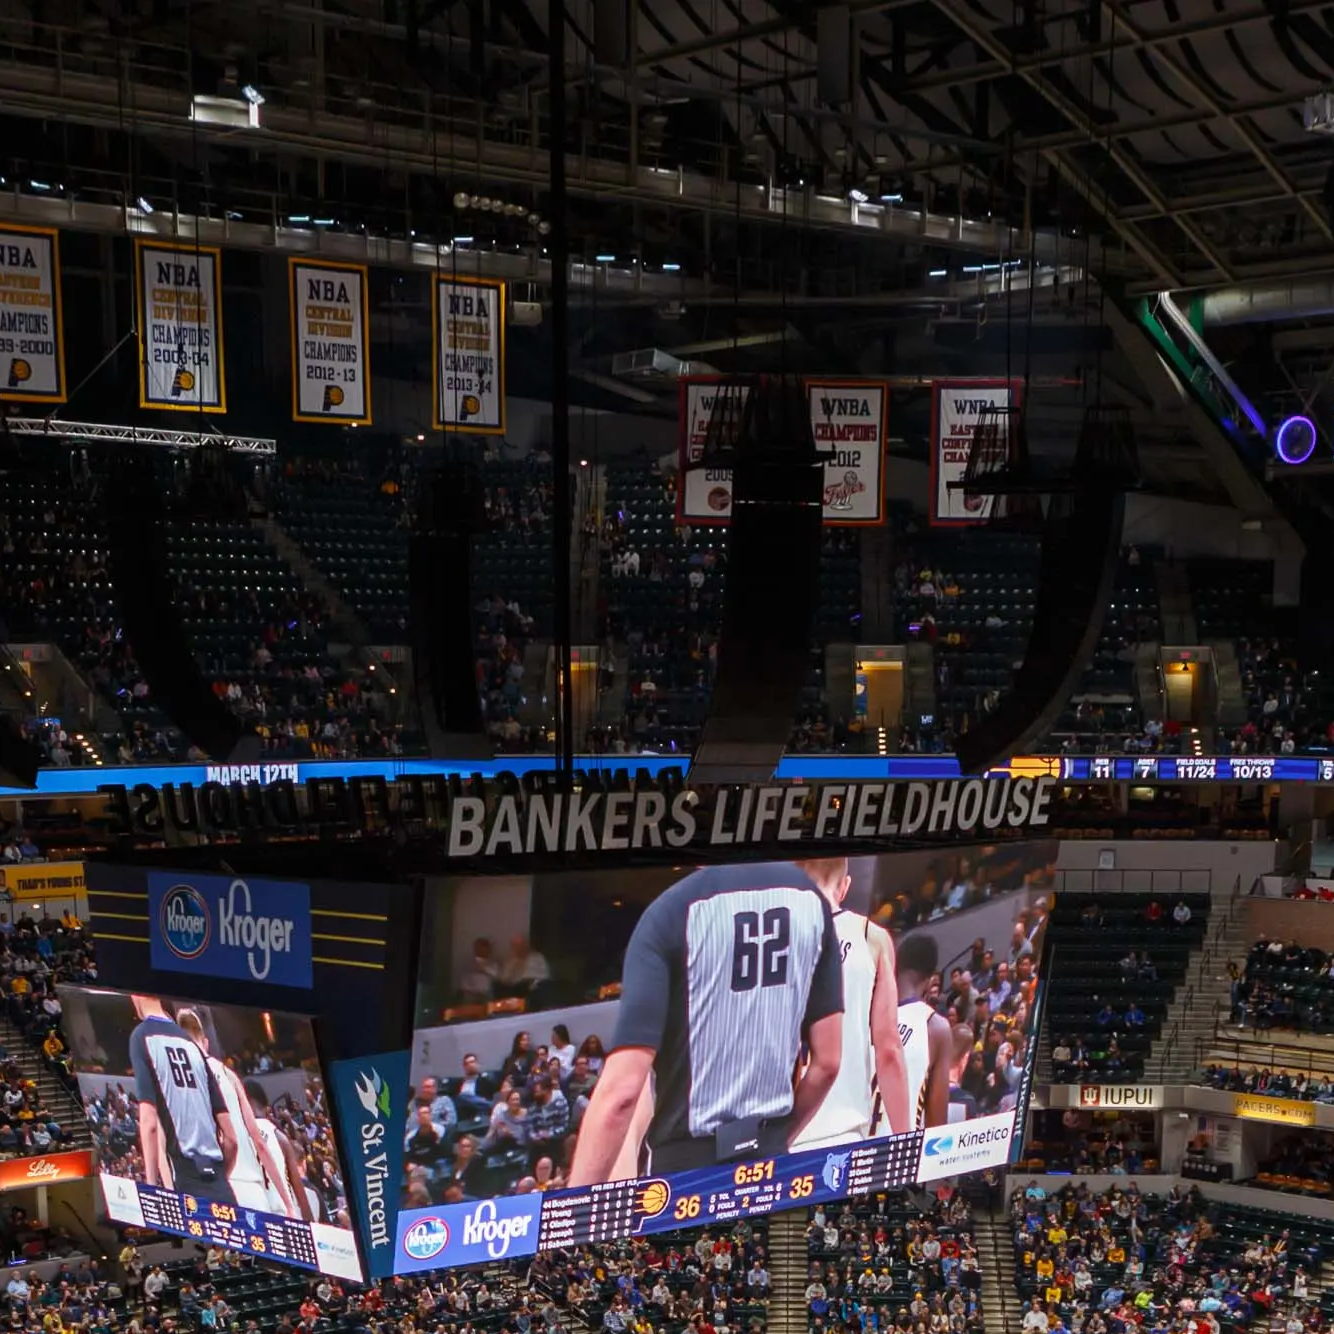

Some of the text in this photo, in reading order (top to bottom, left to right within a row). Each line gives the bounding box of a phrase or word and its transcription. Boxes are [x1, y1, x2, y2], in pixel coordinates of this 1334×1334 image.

[157, 262, 200, 287] NBA
[152, 288, 207, 306] CENTRAL
[308, 279, 349, 303] NBA
[306, 305, 353, 321] CENTRAL
[449, 295, 488, 317] NBA
[152, 324, 210, 347] CHAMPIONS
[447, 320, 490, 336] CENTRAL
[154, 348, 209, 366] 2003-04
[304, 341, 357, 363] CHAMPIONS
[306, 365, 356, 382] 2012-13
[445, 354, 493, 375] CHAMPIONS
[821, 398, 871, 416] WNBA
[815, 423, 877, 441] CHAMPIONS
[828, 450, 860, 467] 2012
[207, 764, 298, 785] MARCH 12TH
[1177, 765, 1217, 779] 11/24
[1232, 766, 1273, 779] 10/13
[448, 778, 1057, 857] BANKERS LIFE FIELDHOUSE
[167, 896, 206, 949] Kroger
[219, 879, 294, 980] Kroger
[731, 906, 790, 992] 62
[165, 1046, 197, 1088] 62
[1105, 1087, 1153, 1104] IUPUI
[957, 1126, 1008, 1149] Kinetico
[27, 1160, 60, 1180] Lilly
[734, 1160, 775, 1185] 6:51
[361, 1122, 391, 1249] St. Vincent
[674, 1175, 815, 1220] 36 2 35
[211, 1203, 236, 1221] 6:51
[188, 1221, 266, 1252] 36 35
[463, 1200, 532, 1258] Kroger
